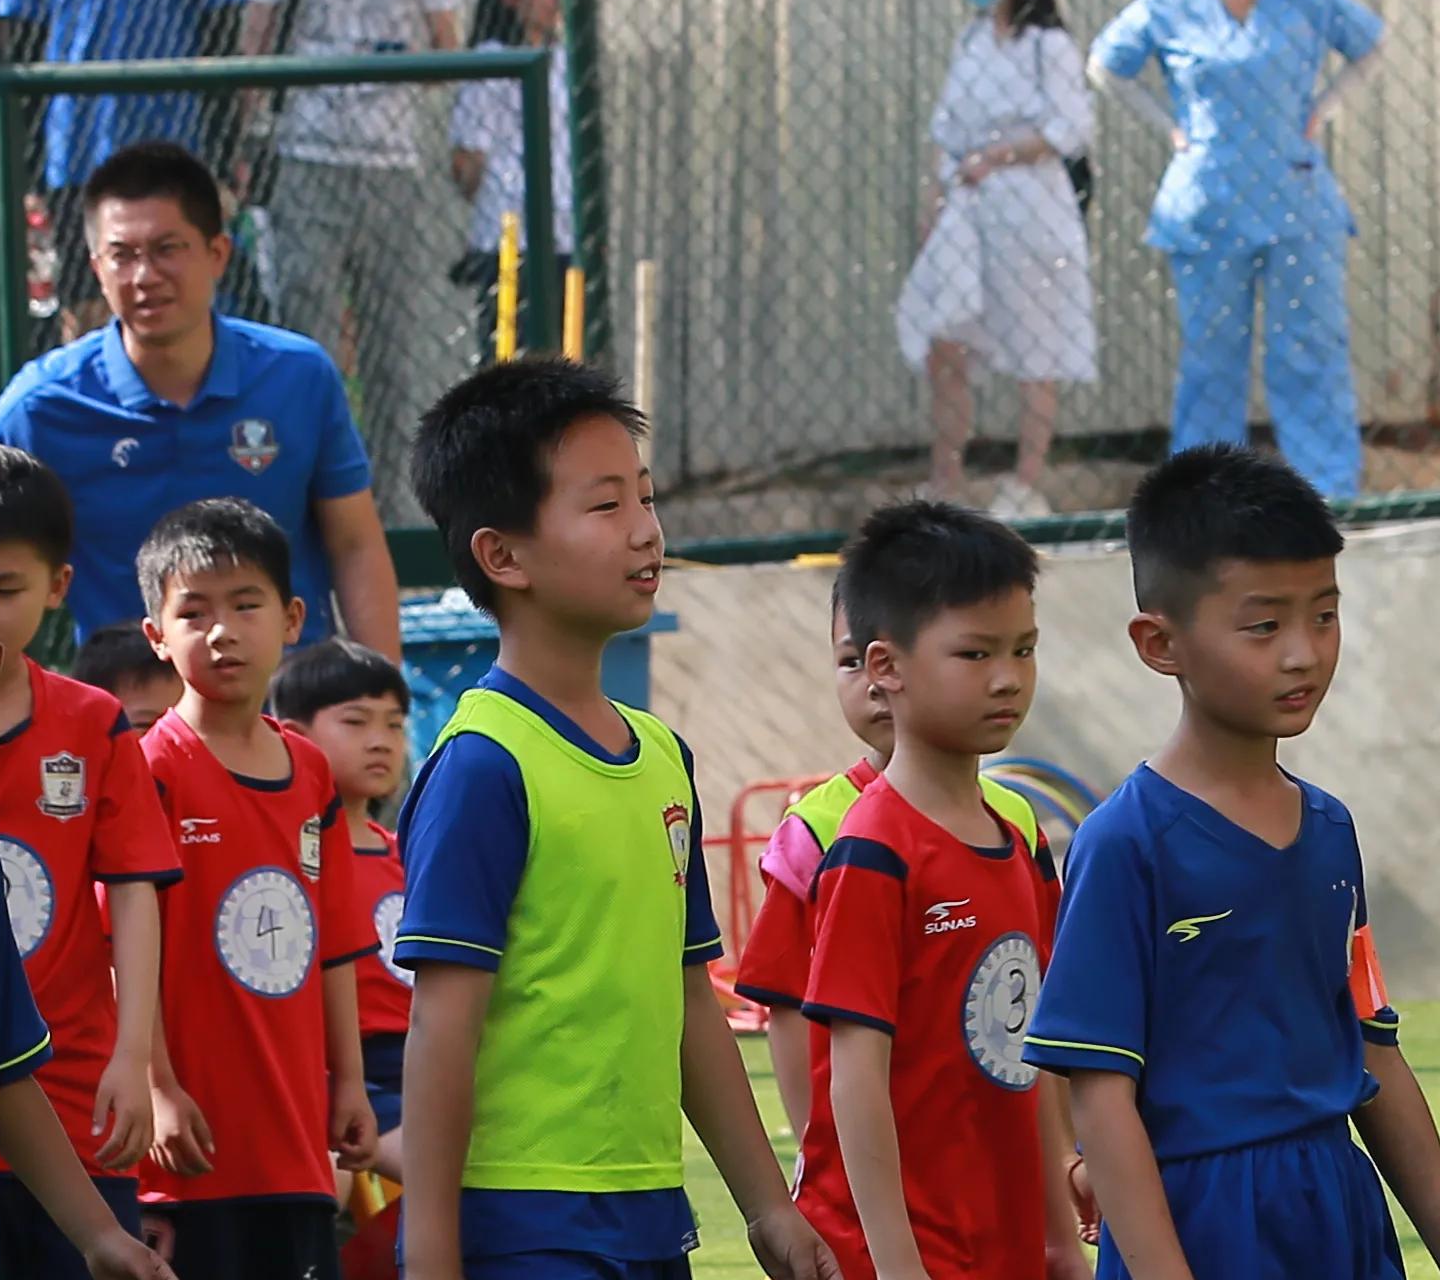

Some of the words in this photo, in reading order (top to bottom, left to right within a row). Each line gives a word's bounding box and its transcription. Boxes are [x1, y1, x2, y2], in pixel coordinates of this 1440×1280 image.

[255, 905, 284, 961] 4
[924, 915, 977, 935] SUNAIS
[1004, 968, 1028, 1034] 3
